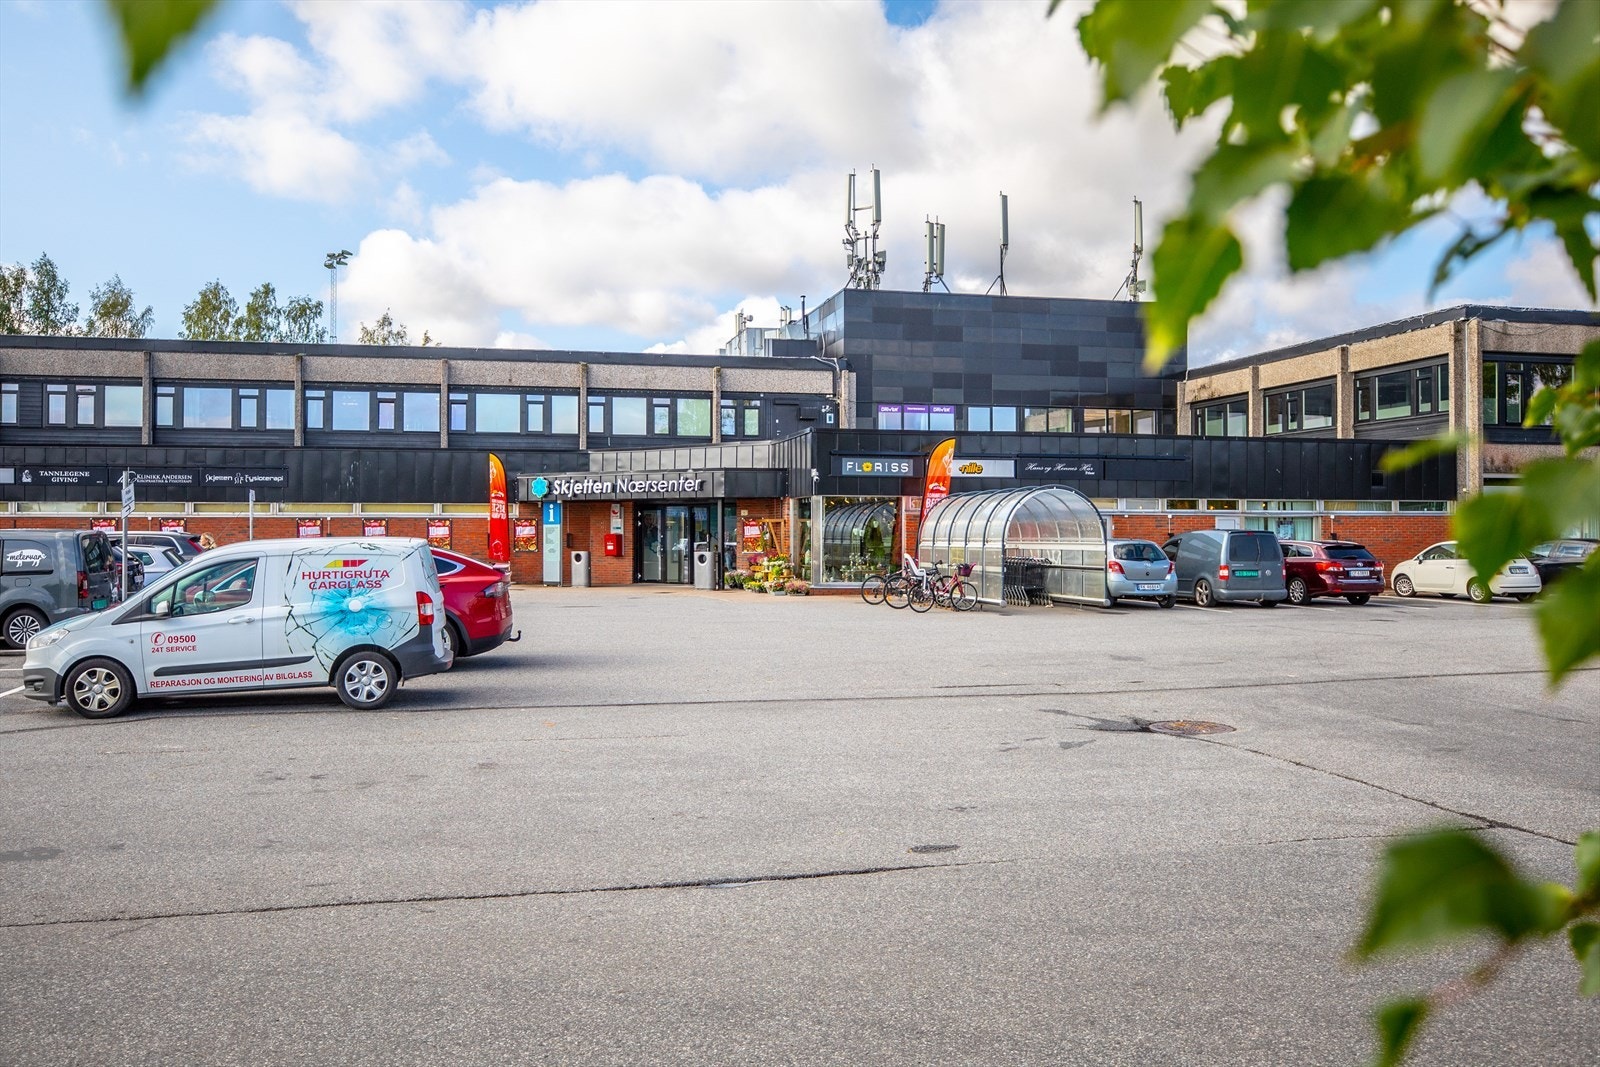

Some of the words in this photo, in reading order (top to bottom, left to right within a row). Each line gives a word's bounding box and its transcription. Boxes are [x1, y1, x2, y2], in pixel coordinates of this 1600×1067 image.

[846, 461, 909, 473] FLORISS
[960, 461, 984, 474] nille
[1053, 462, 1078, 472] Hennes
[205, 473, 233, 483] Skjetten
[245, 473, 284, 483] Fysioterapi
[553, 477, 612, 498] Skjetten
[616, 475, 703, 494] Nærsenter
[548, 503, 555, 522] i
[9, 550, 42, 561] metervar
[301, 569, 390, 580] HURTIGRUTA
[308, 579, 383, 590] CARGLASS
[167, 634, 196, 644] 09500
[165, 645, 197, 653] SERVICE
[150, 678, 202, 688] REPARASJON
[203, 677, 216, 685] OG
[217, 674, 263, 684] MONTERING
[263, 673, 275, 681] AV
[276, 671, 313, 680] BILGLASS
